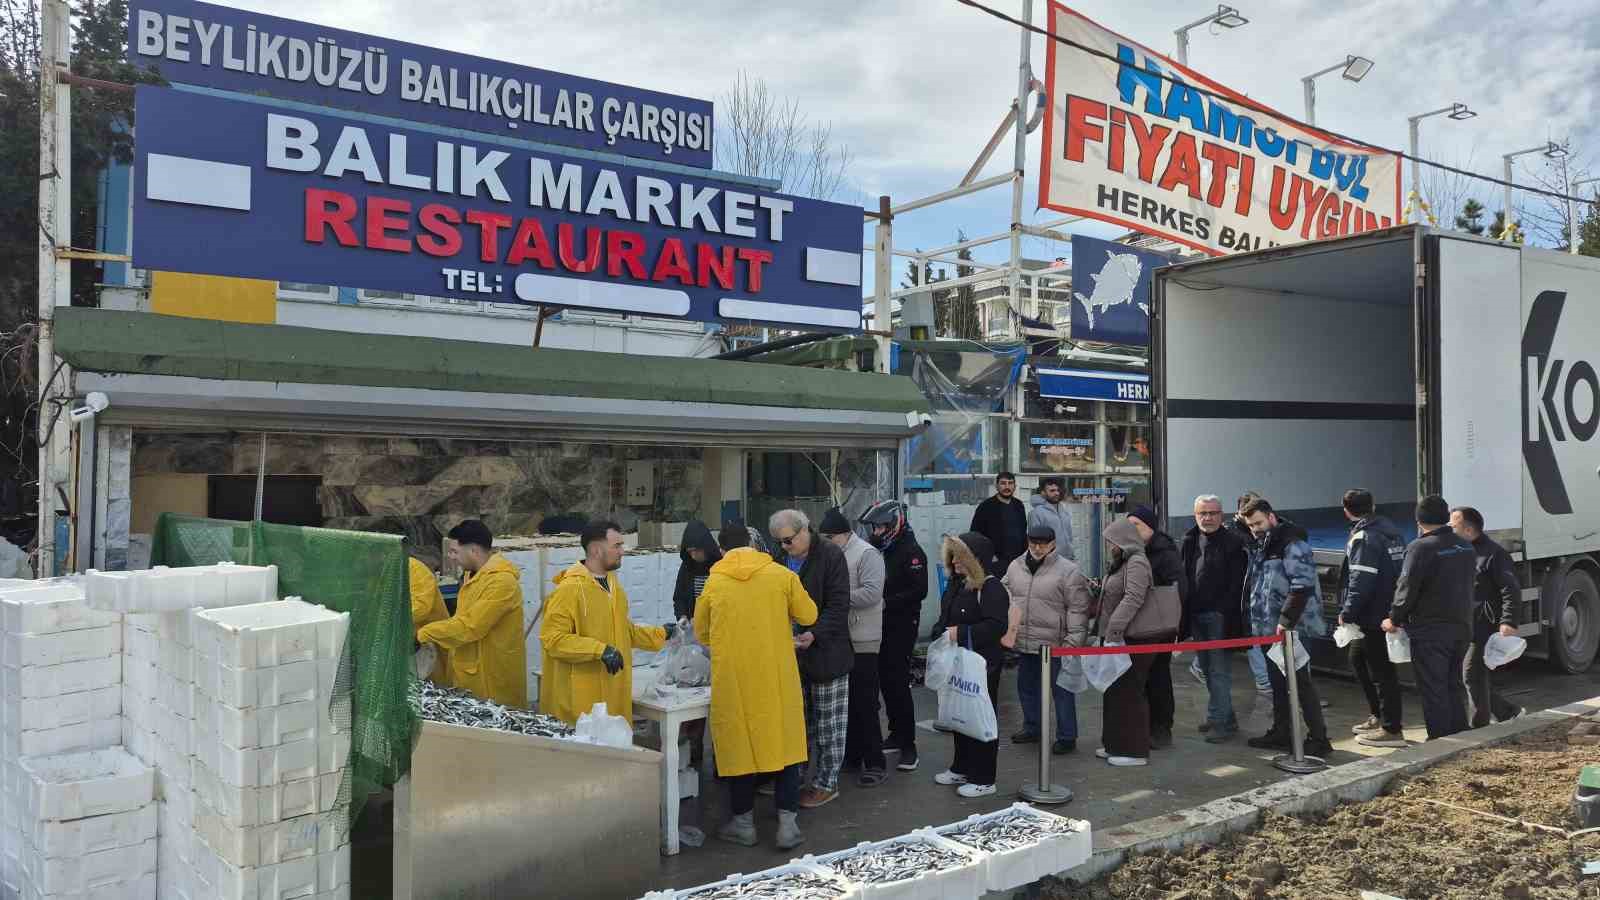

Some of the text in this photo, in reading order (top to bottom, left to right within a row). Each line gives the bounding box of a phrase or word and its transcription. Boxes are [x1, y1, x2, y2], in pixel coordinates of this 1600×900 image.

[137, 9, 711, 154] BEYLİKDÜZÜ BALIKÇILAR ÇARŞISI
[266, 112, 794, 242] BALIK MARKET
[1097, 183, 1211, 241] HERKES
[305, 187, 774, 294] RESTAURANT
[441, 267, 503, 294] TEL:
